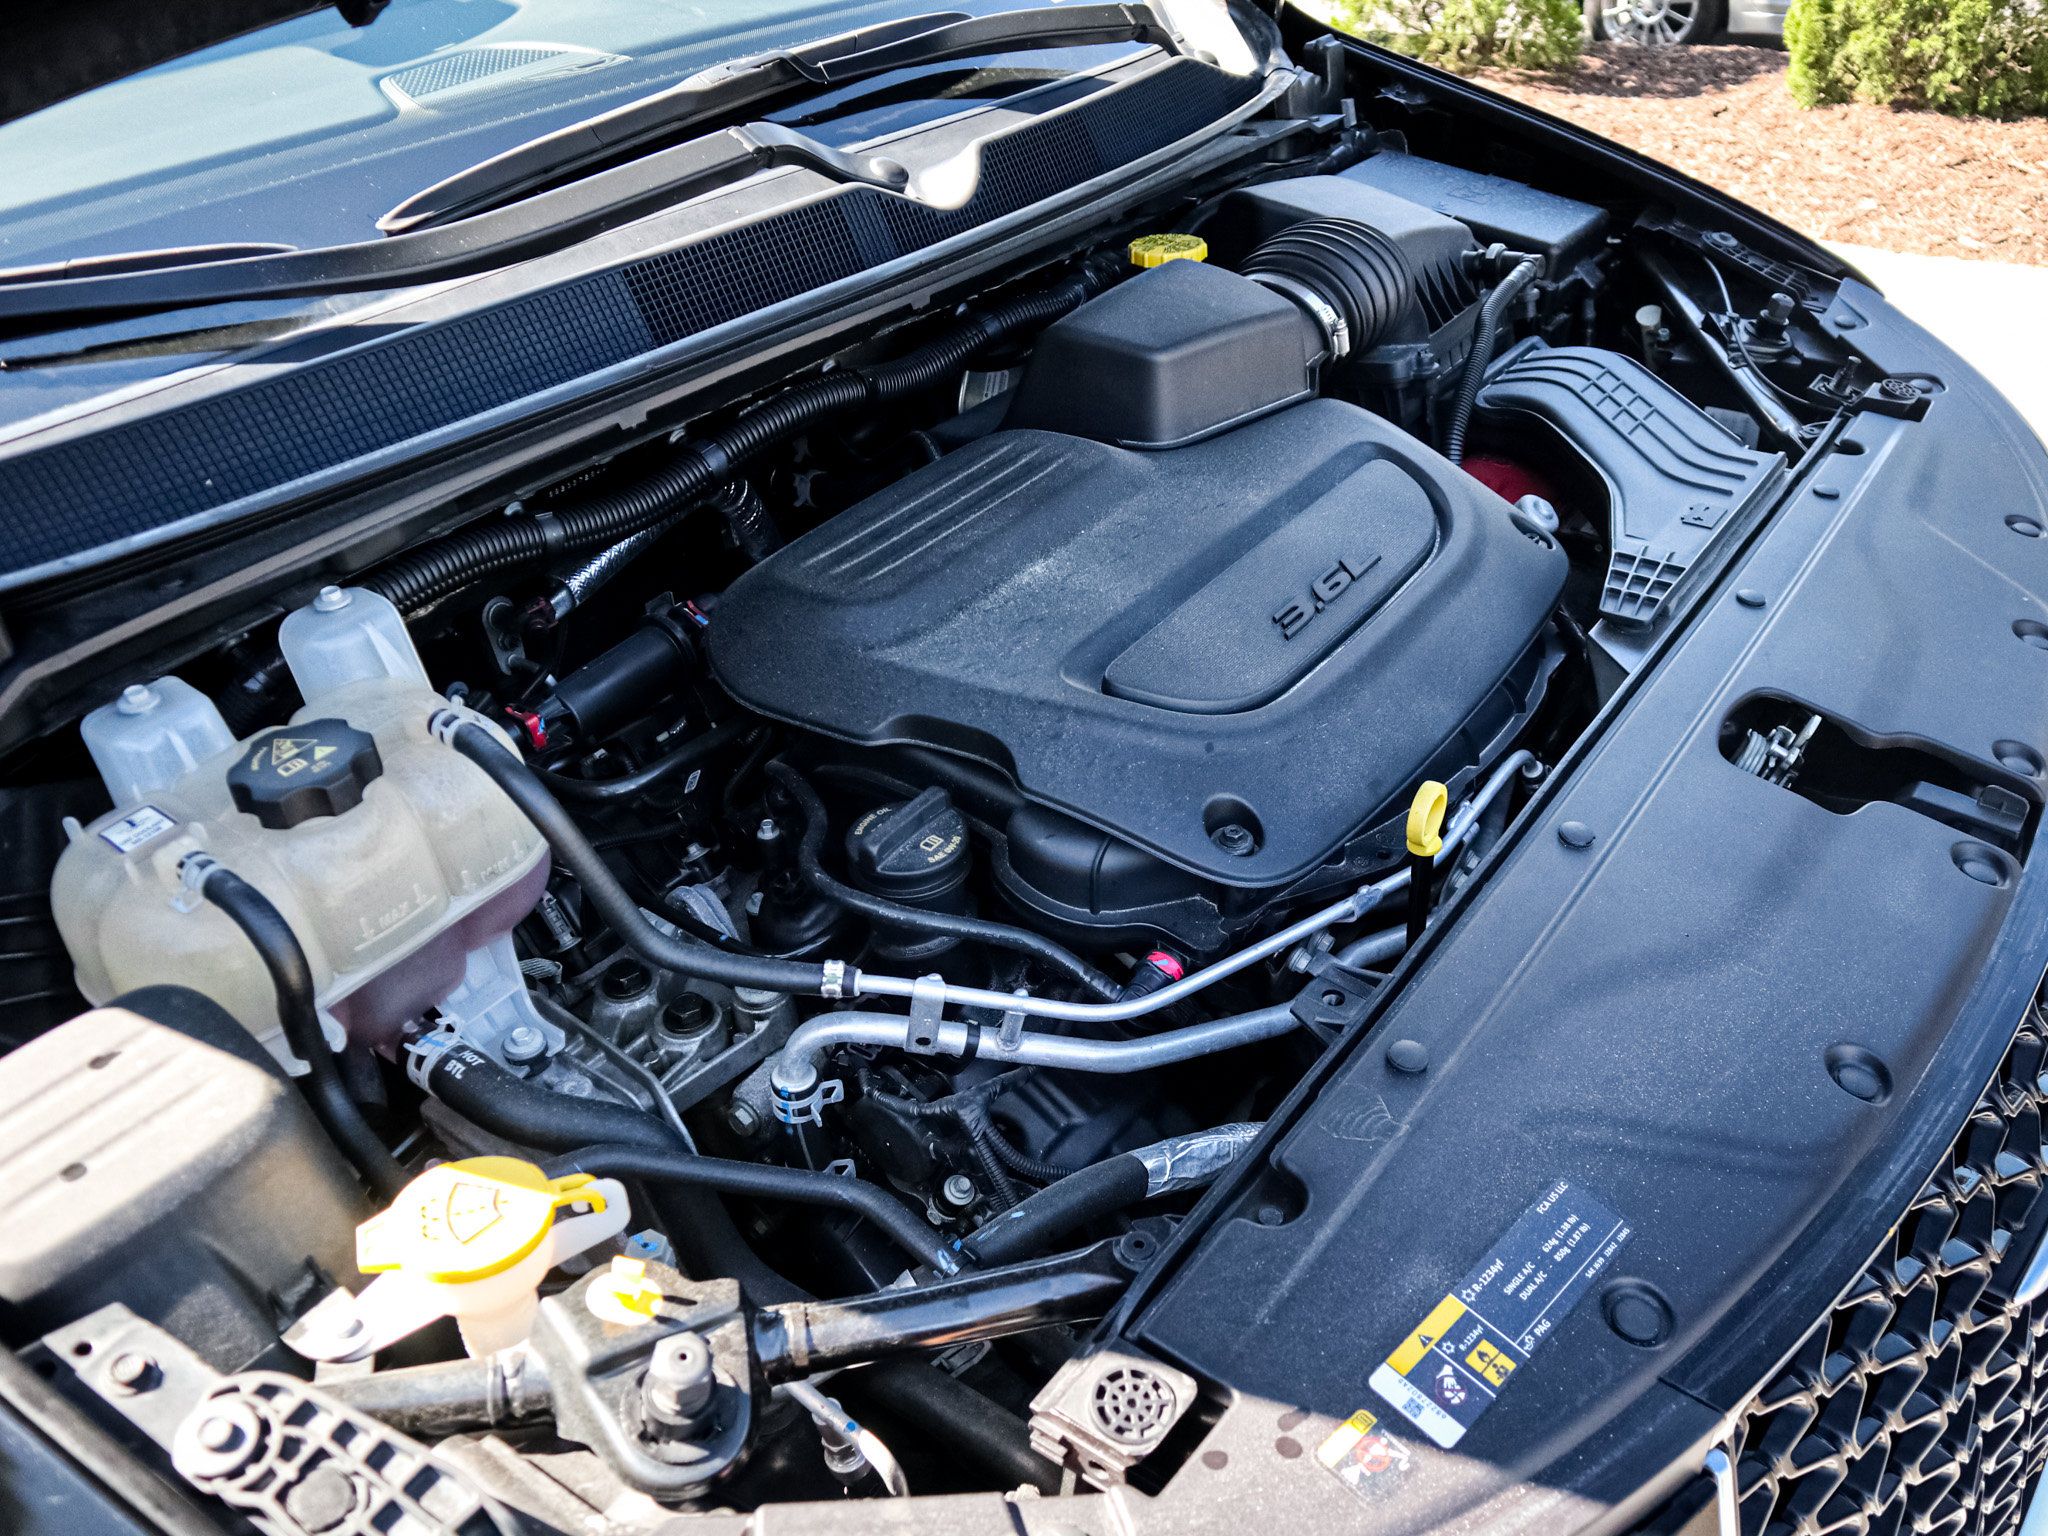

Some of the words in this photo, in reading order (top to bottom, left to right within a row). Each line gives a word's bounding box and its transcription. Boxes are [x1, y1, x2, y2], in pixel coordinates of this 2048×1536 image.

[1272, 556, 1382, 641] 3.6L
[854, 813, 877, 836] ENGINE
[876, 807, 893, 816] OIL
[443, 1059, 466, 1080] BTL
[459, 1049, 486, 1066] HOT
[1537, 1201, 1552, 1215] FCA
[1548, 1192, 1559, 1203] US
[1556, 1182, 1569, 1195] LLC
[1472, 1258, 1505, 1293] R-1234yf
[1504, 1273, 1526, 1296] SINGLE
[1522, 1261, 1536, 1276] A/C
[1542, 1238, 1559, 1253] 624g
[1555, 1223, 1572, 1239] (1.38
[1520, 1283, 1538, 1301] DUAL
[1534, 1271, 1548, 1286] A/C
[1554, 1246, 1571, 1262] 850g
[1567, 1231, 1582, 1248] (1.87
[1534, 1319, 1552, 1337] PAG
